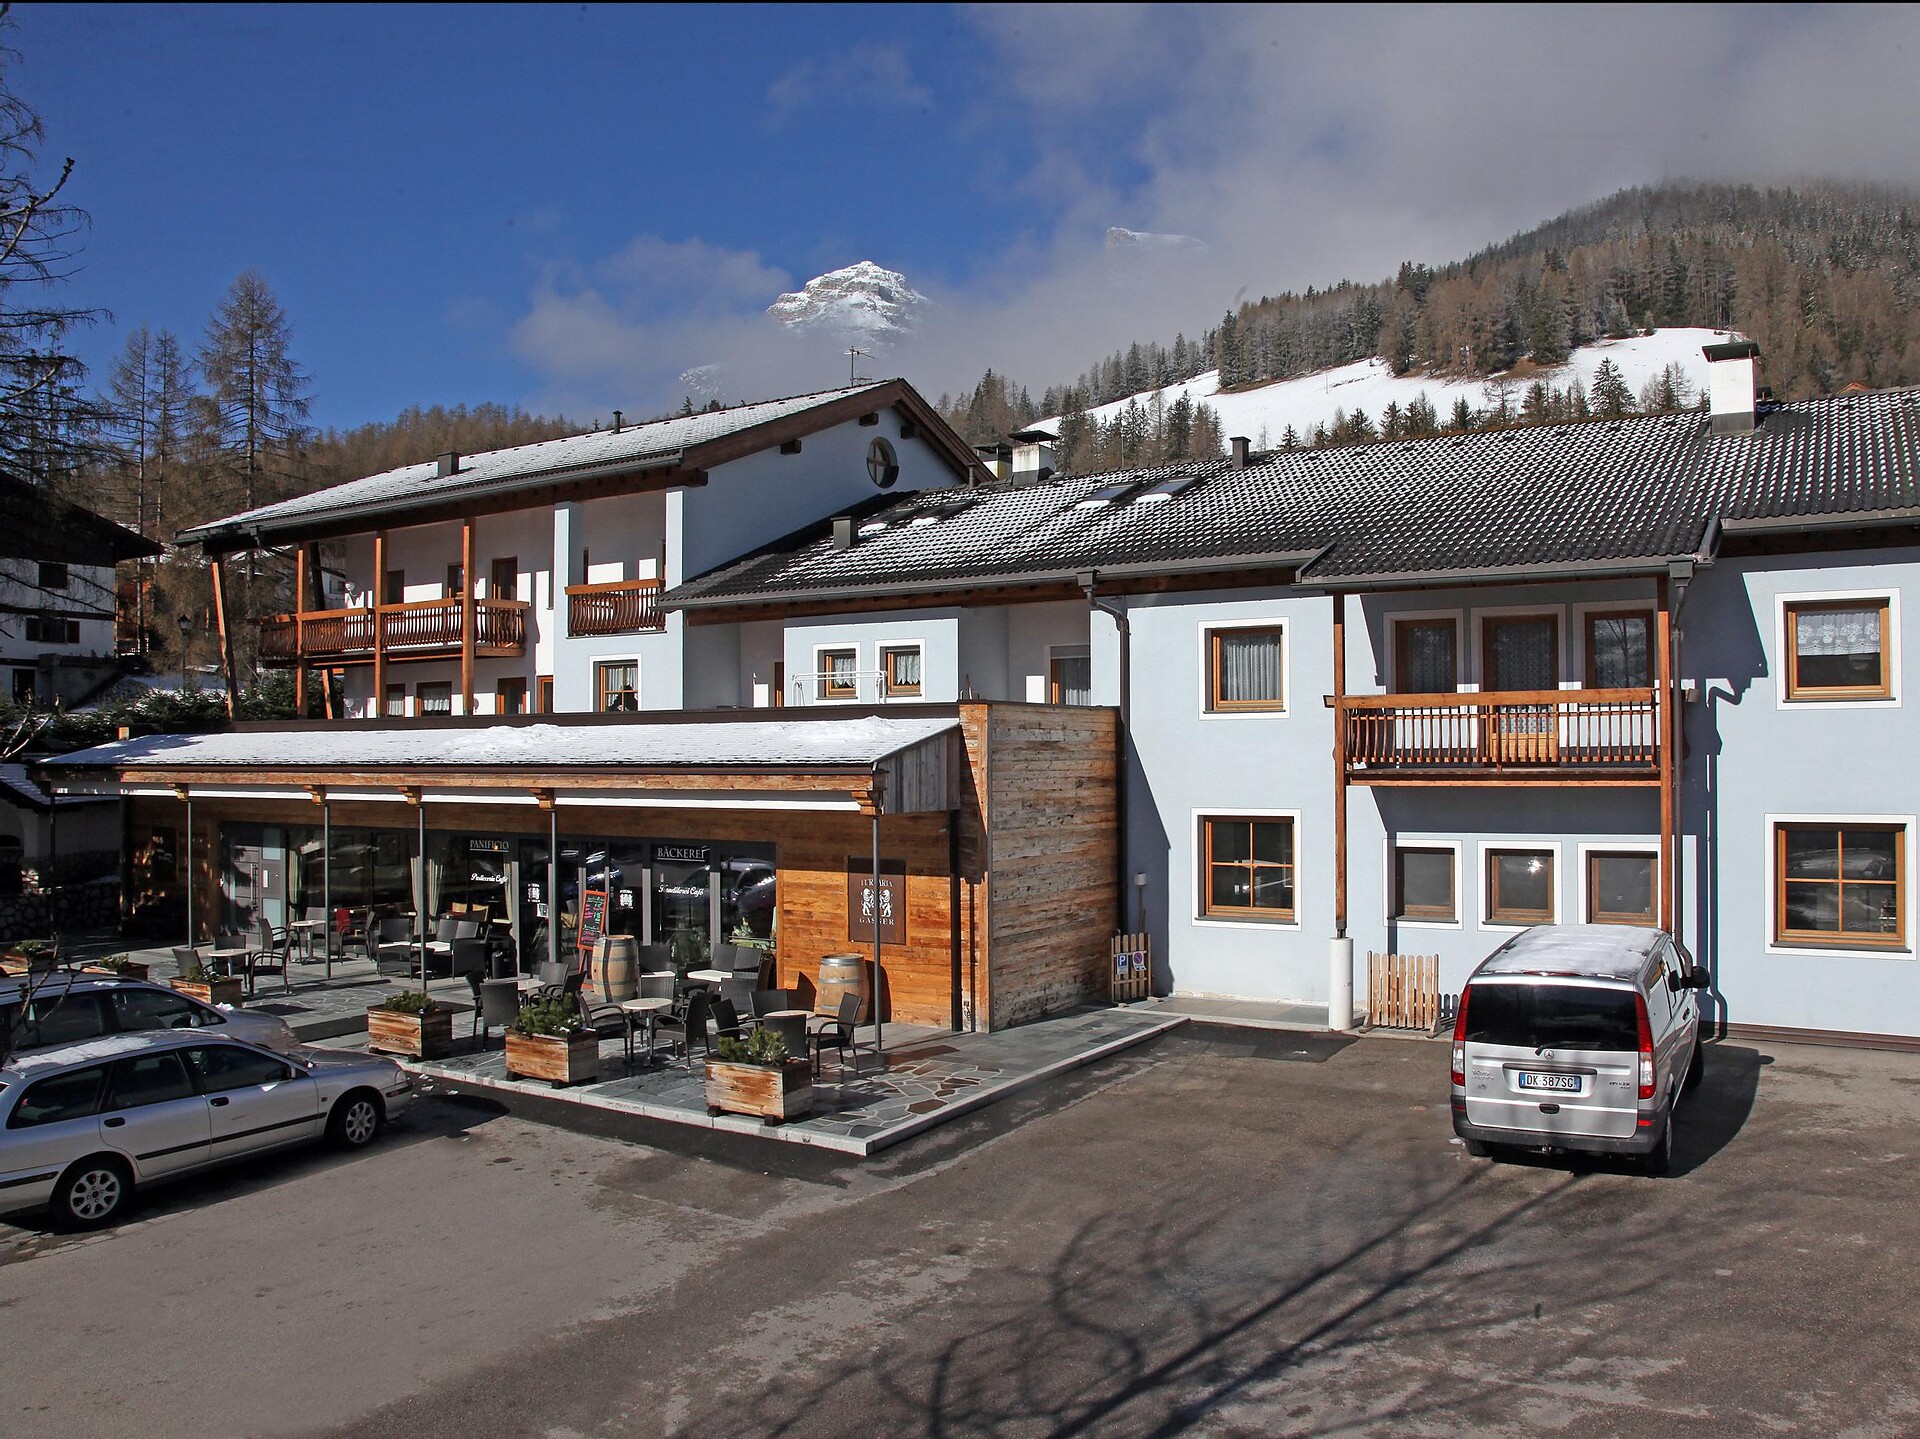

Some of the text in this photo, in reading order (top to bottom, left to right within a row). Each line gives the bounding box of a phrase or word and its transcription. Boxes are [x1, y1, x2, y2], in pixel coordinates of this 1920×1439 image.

[469, 839, 509, 850] PANIFICIO
[657, 845, 705, 859] BÄCKEREI
[1119, 955, 1126, 966] P
[1526, 1074, 1539, 1085] DK
